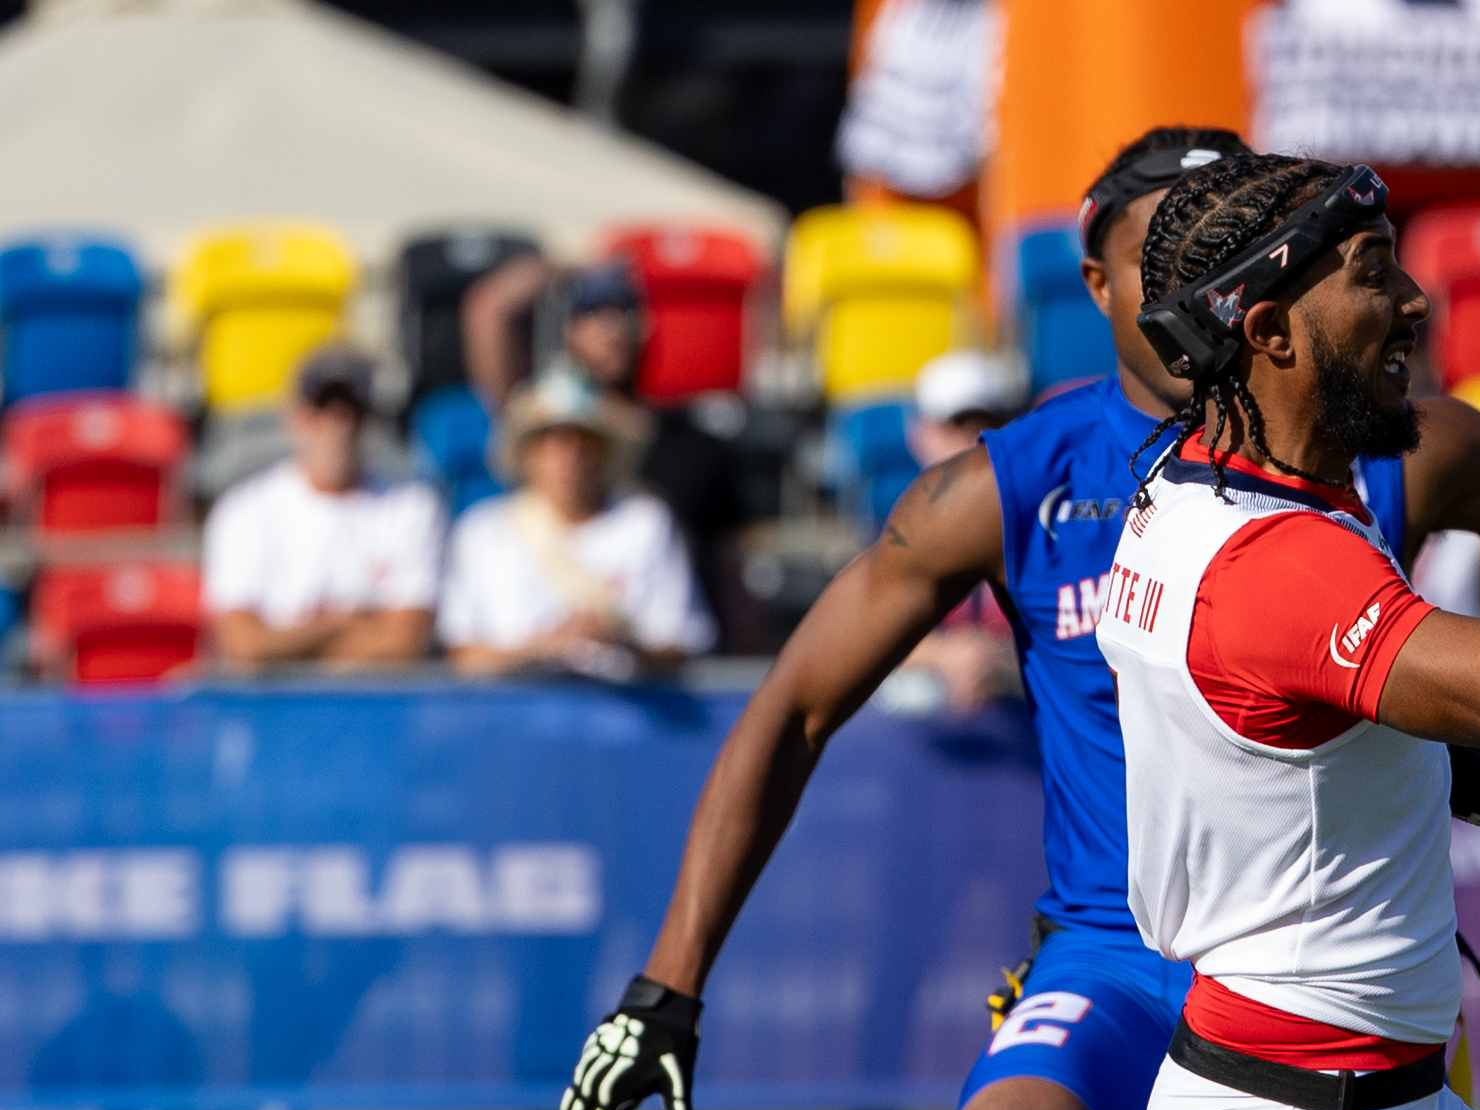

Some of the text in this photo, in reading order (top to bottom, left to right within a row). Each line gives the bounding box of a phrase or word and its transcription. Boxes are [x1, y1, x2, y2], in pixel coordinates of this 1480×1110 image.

[1269, 243, 1289, 269] 7
[1057, 499, 1122, 523] IFAF
[1139, 578, 1164, 633] III
[1341, 602, 1380, 654] IFAF
[989, 990, 1093, 1058] 2
